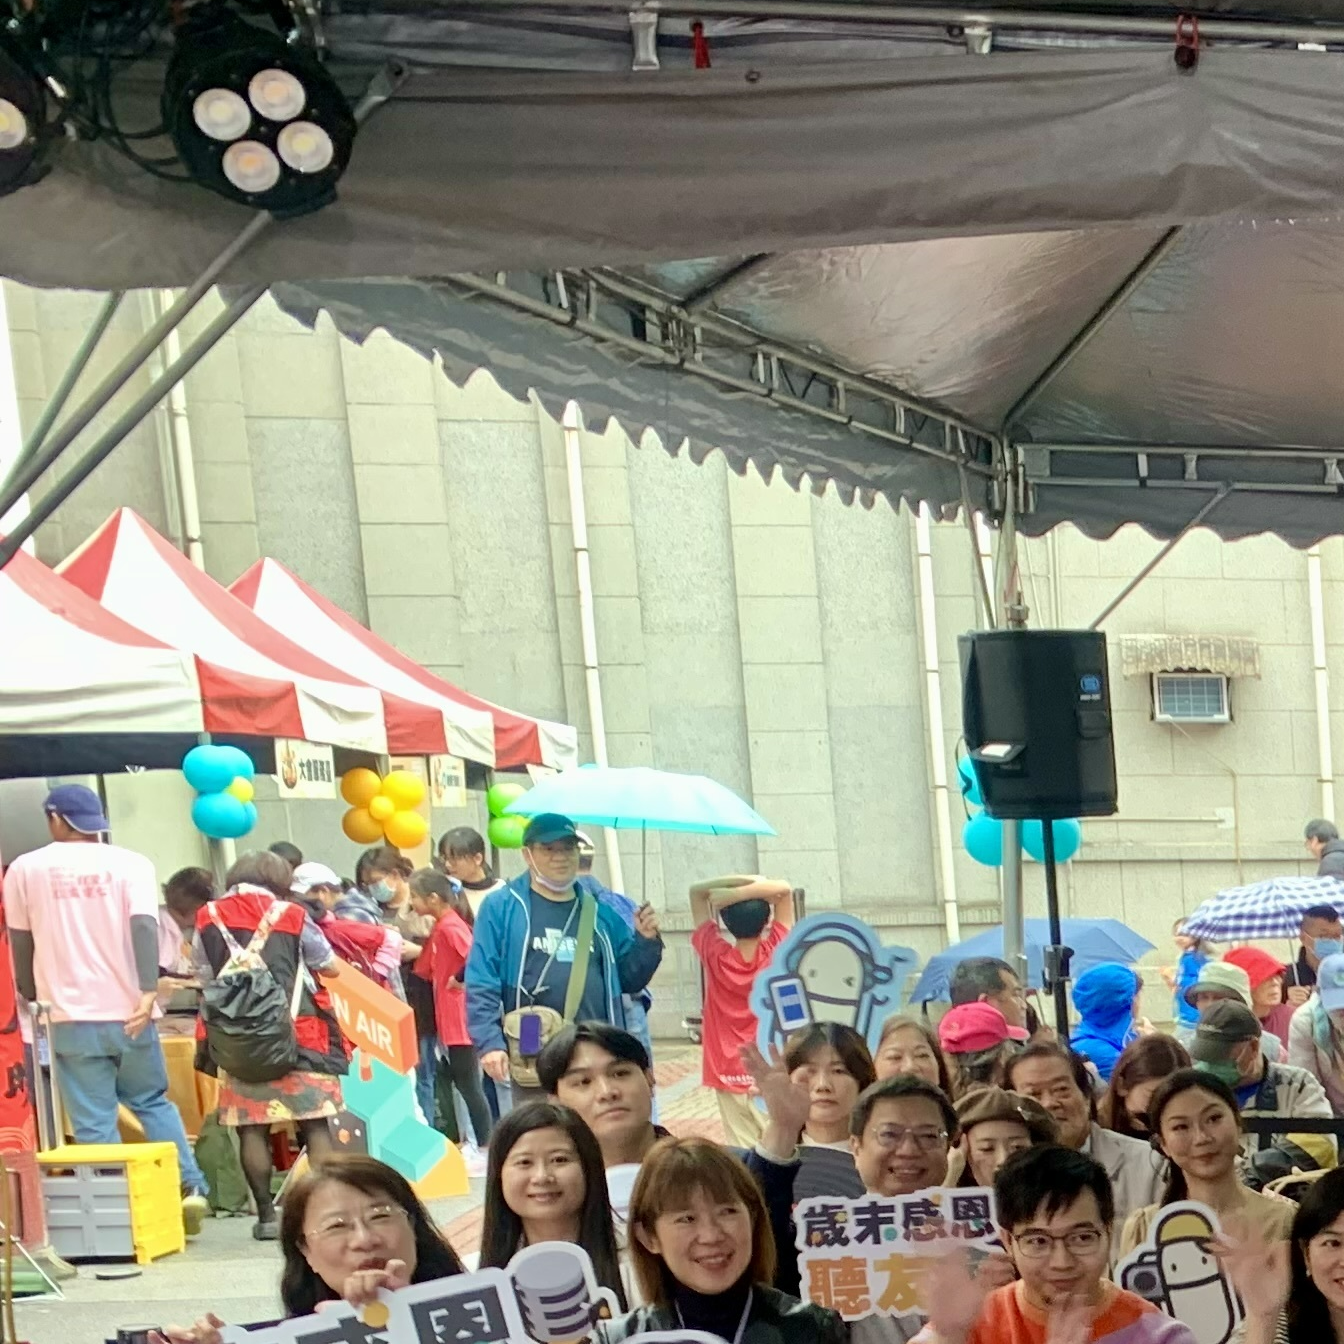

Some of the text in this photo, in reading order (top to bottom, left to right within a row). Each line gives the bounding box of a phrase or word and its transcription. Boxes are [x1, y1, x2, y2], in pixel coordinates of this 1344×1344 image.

[330, 990, 394, 1058] N AIR
[803, 1194, 997, 1248] 歲末感恩
